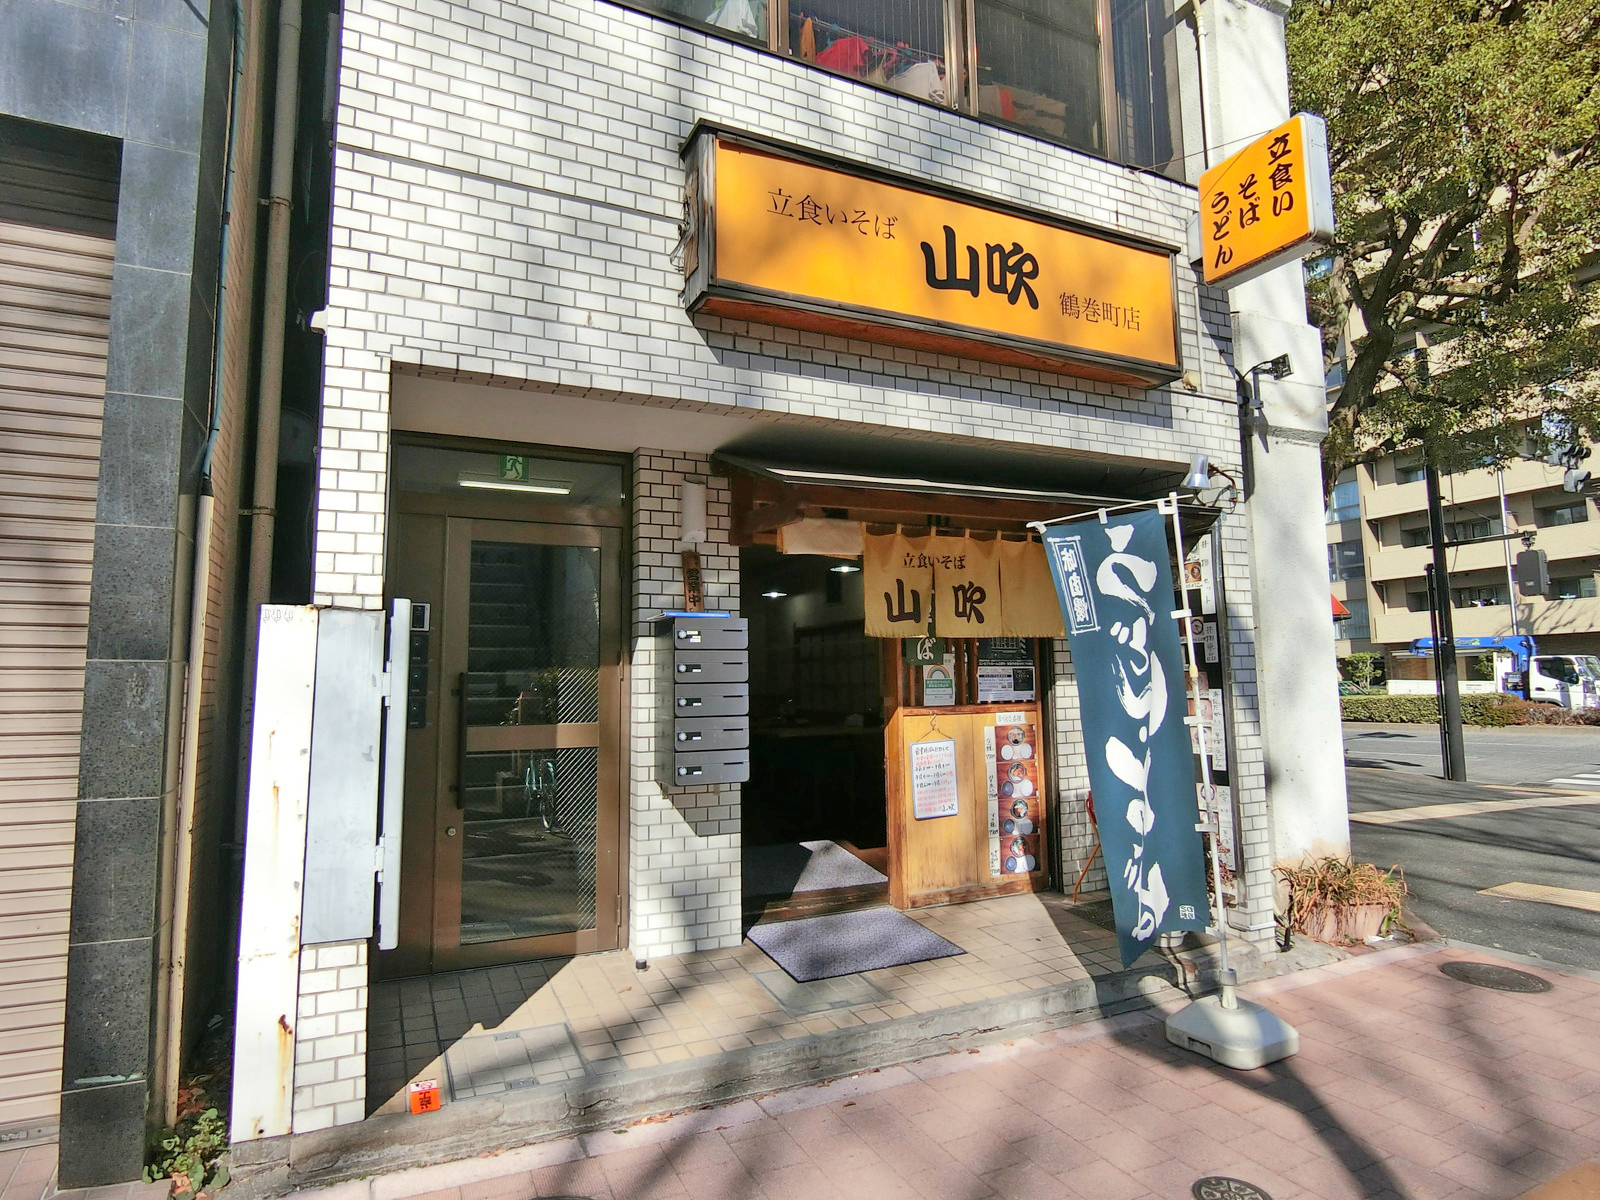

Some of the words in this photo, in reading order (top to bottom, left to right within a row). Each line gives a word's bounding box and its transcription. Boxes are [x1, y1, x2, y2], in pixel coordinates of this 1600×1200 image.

[1238, 173, 1261, 229] そば
[1267, 135, 1295, 219] 立食い
[766, 187, 897, 242] 立食いそば
[1207, 191, 1235, 269] うどん
[920, 224, 1039, 310] 山吹
[1058, 290, 1142, 333] 鶴巻町店
[903, 552, 966, 570] 立食いそば
